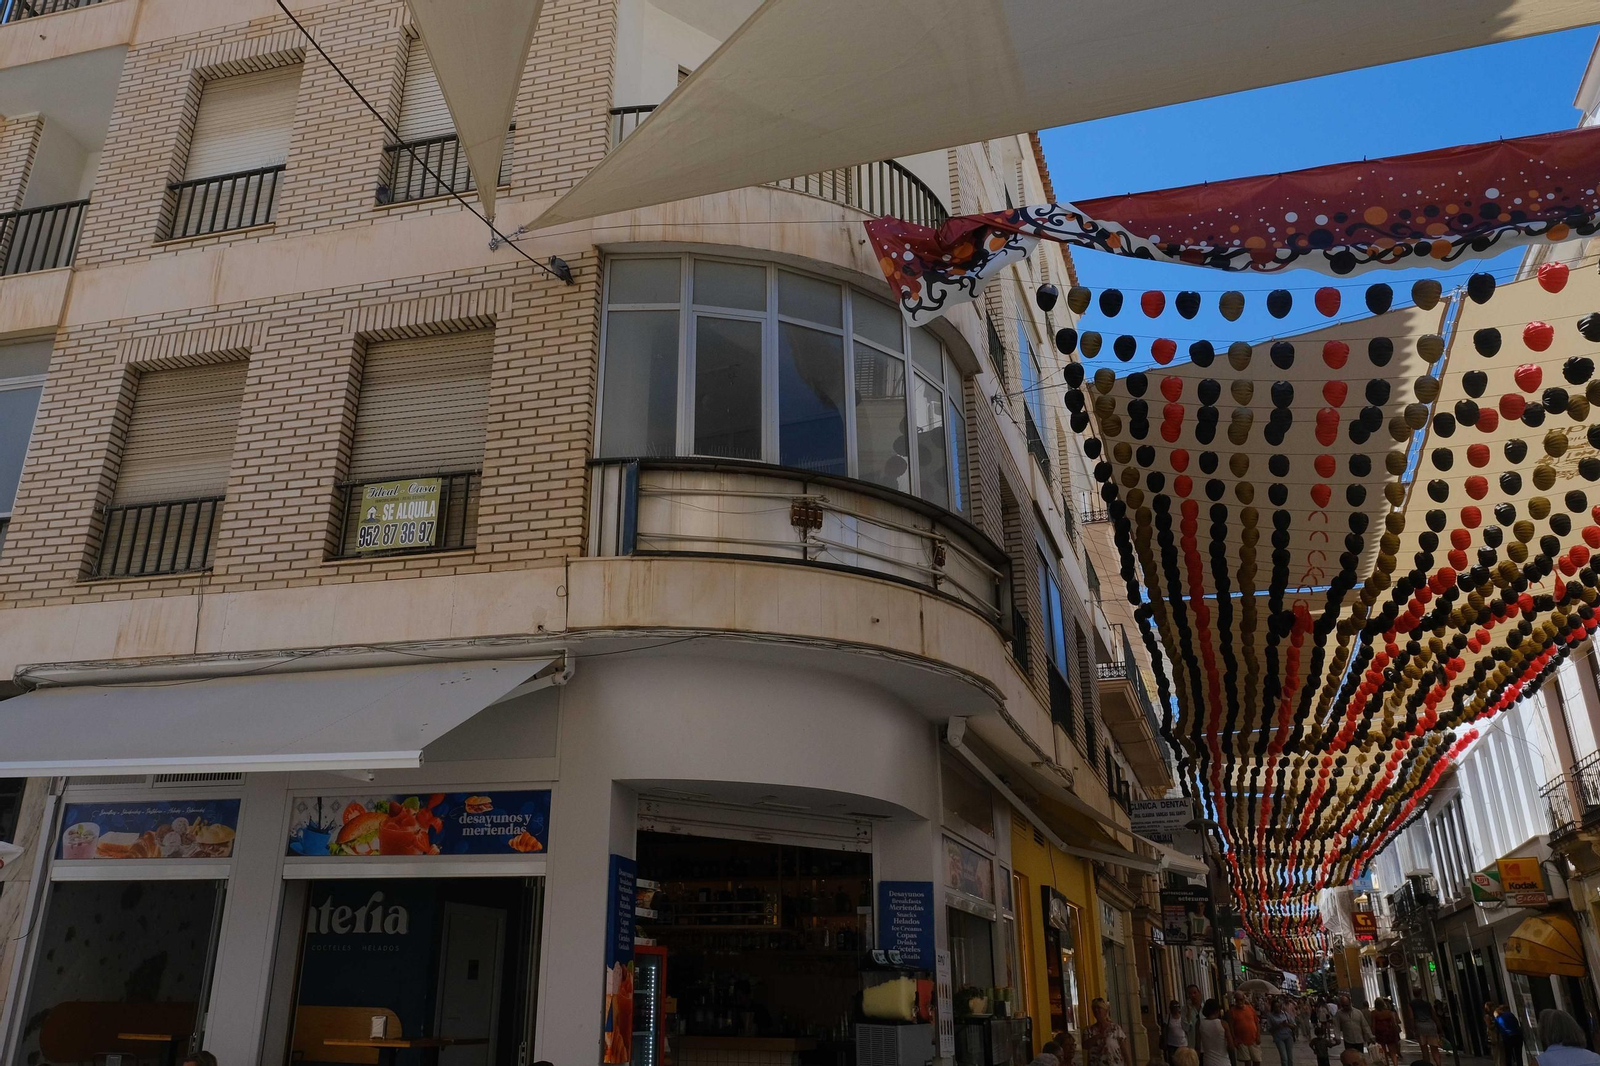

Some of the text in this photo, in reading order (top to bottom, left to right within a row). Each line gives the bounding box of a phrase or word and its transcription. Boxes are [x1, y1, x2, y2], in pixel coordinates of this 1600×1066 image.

[408, 483, 436, 494] Casa
[382, 500, 436, 521] SE ALQUILA
[359, 521, 435, 548] 952 87 36 97
[1160, 800, 1189, 808] DENTAL
[459, 812, 532, 826] desayunos y
[462, 823, 528, 836] meriendas
[1508, 881, 1539, 890] Kodak
[888, 890, 925, 899] Desayunos
[896, 932, 917, 940] Copas
[361, 944, 400, 952] HELADOS
